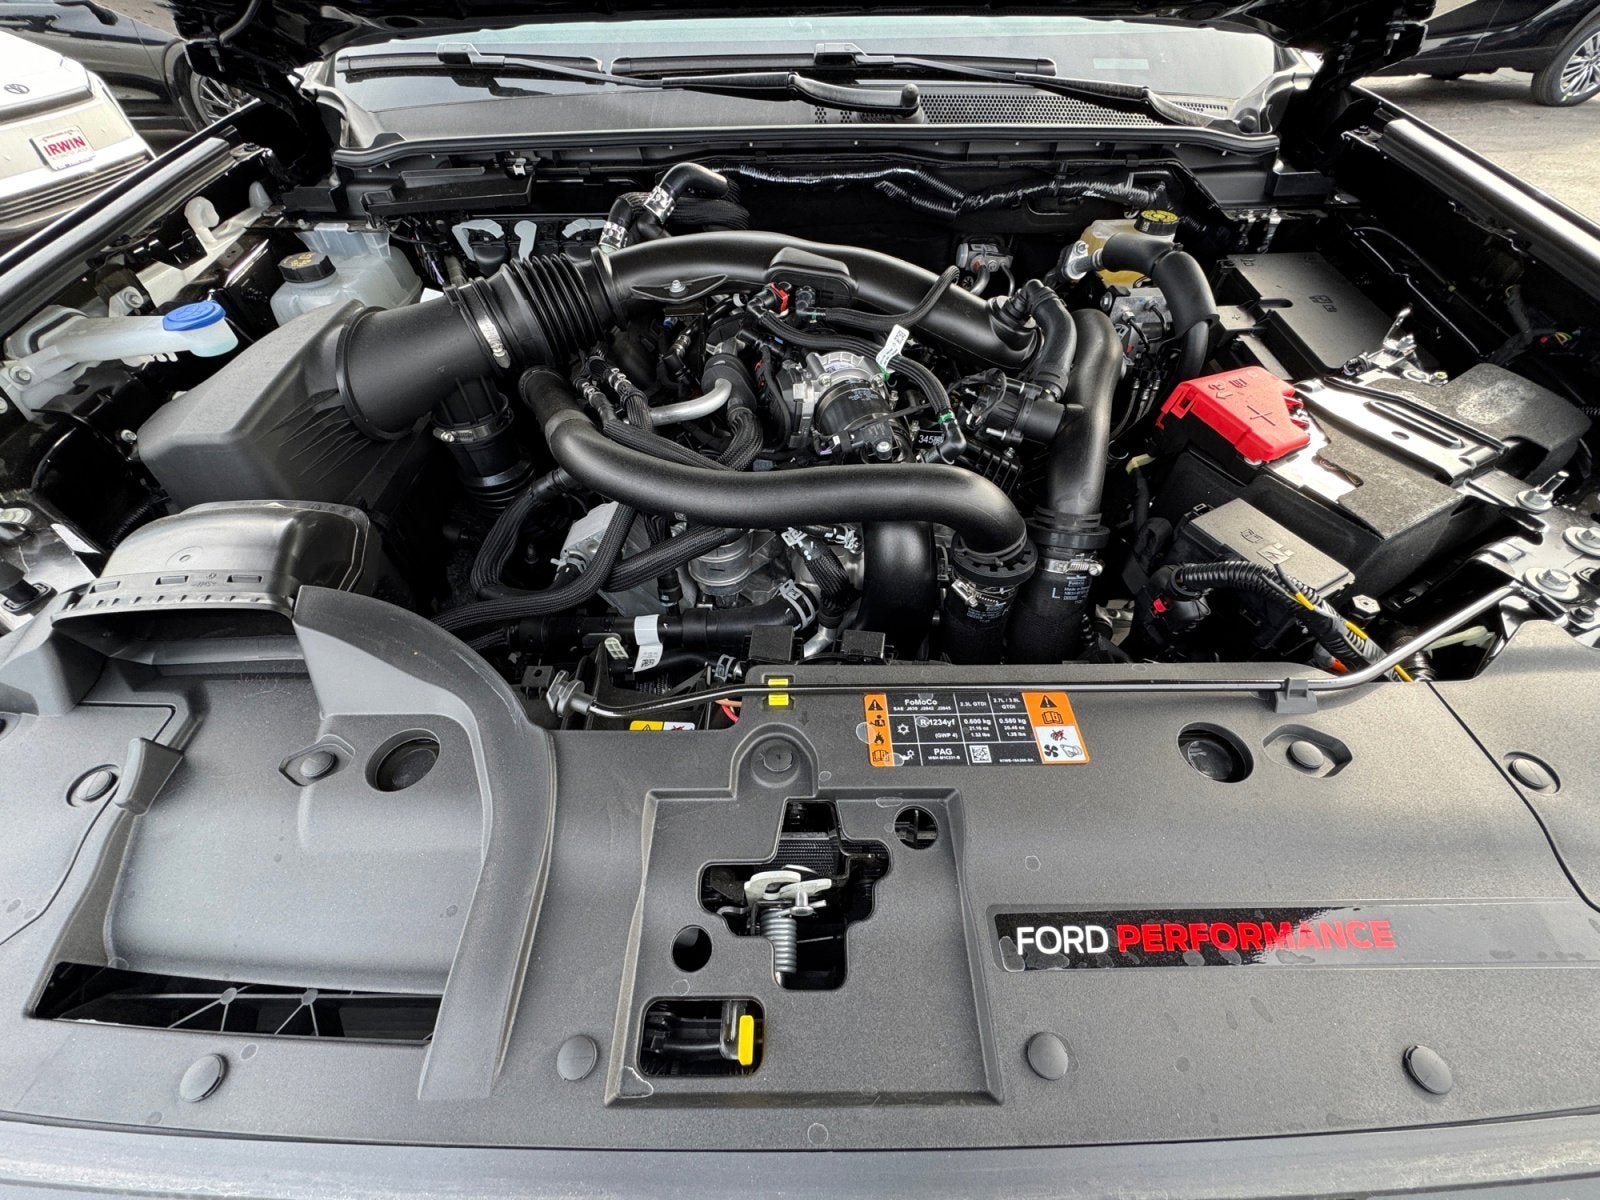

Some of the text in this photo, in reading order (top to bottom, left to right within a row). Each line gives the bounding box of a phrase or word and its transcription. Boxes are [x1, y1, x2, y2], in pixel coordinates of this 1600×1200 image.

[43, 136, 86, 157] IRWIN
[918, 434, 934, 444] 345
[1051, 587, 1060, 599] L
[920, 718, 956, 727] R-1234yf
[982, 718, 991, 726] kg
[1018, 717, 1027, 725] kg
[1015, 920, 1397, 955] FORD PERFORMANCE
